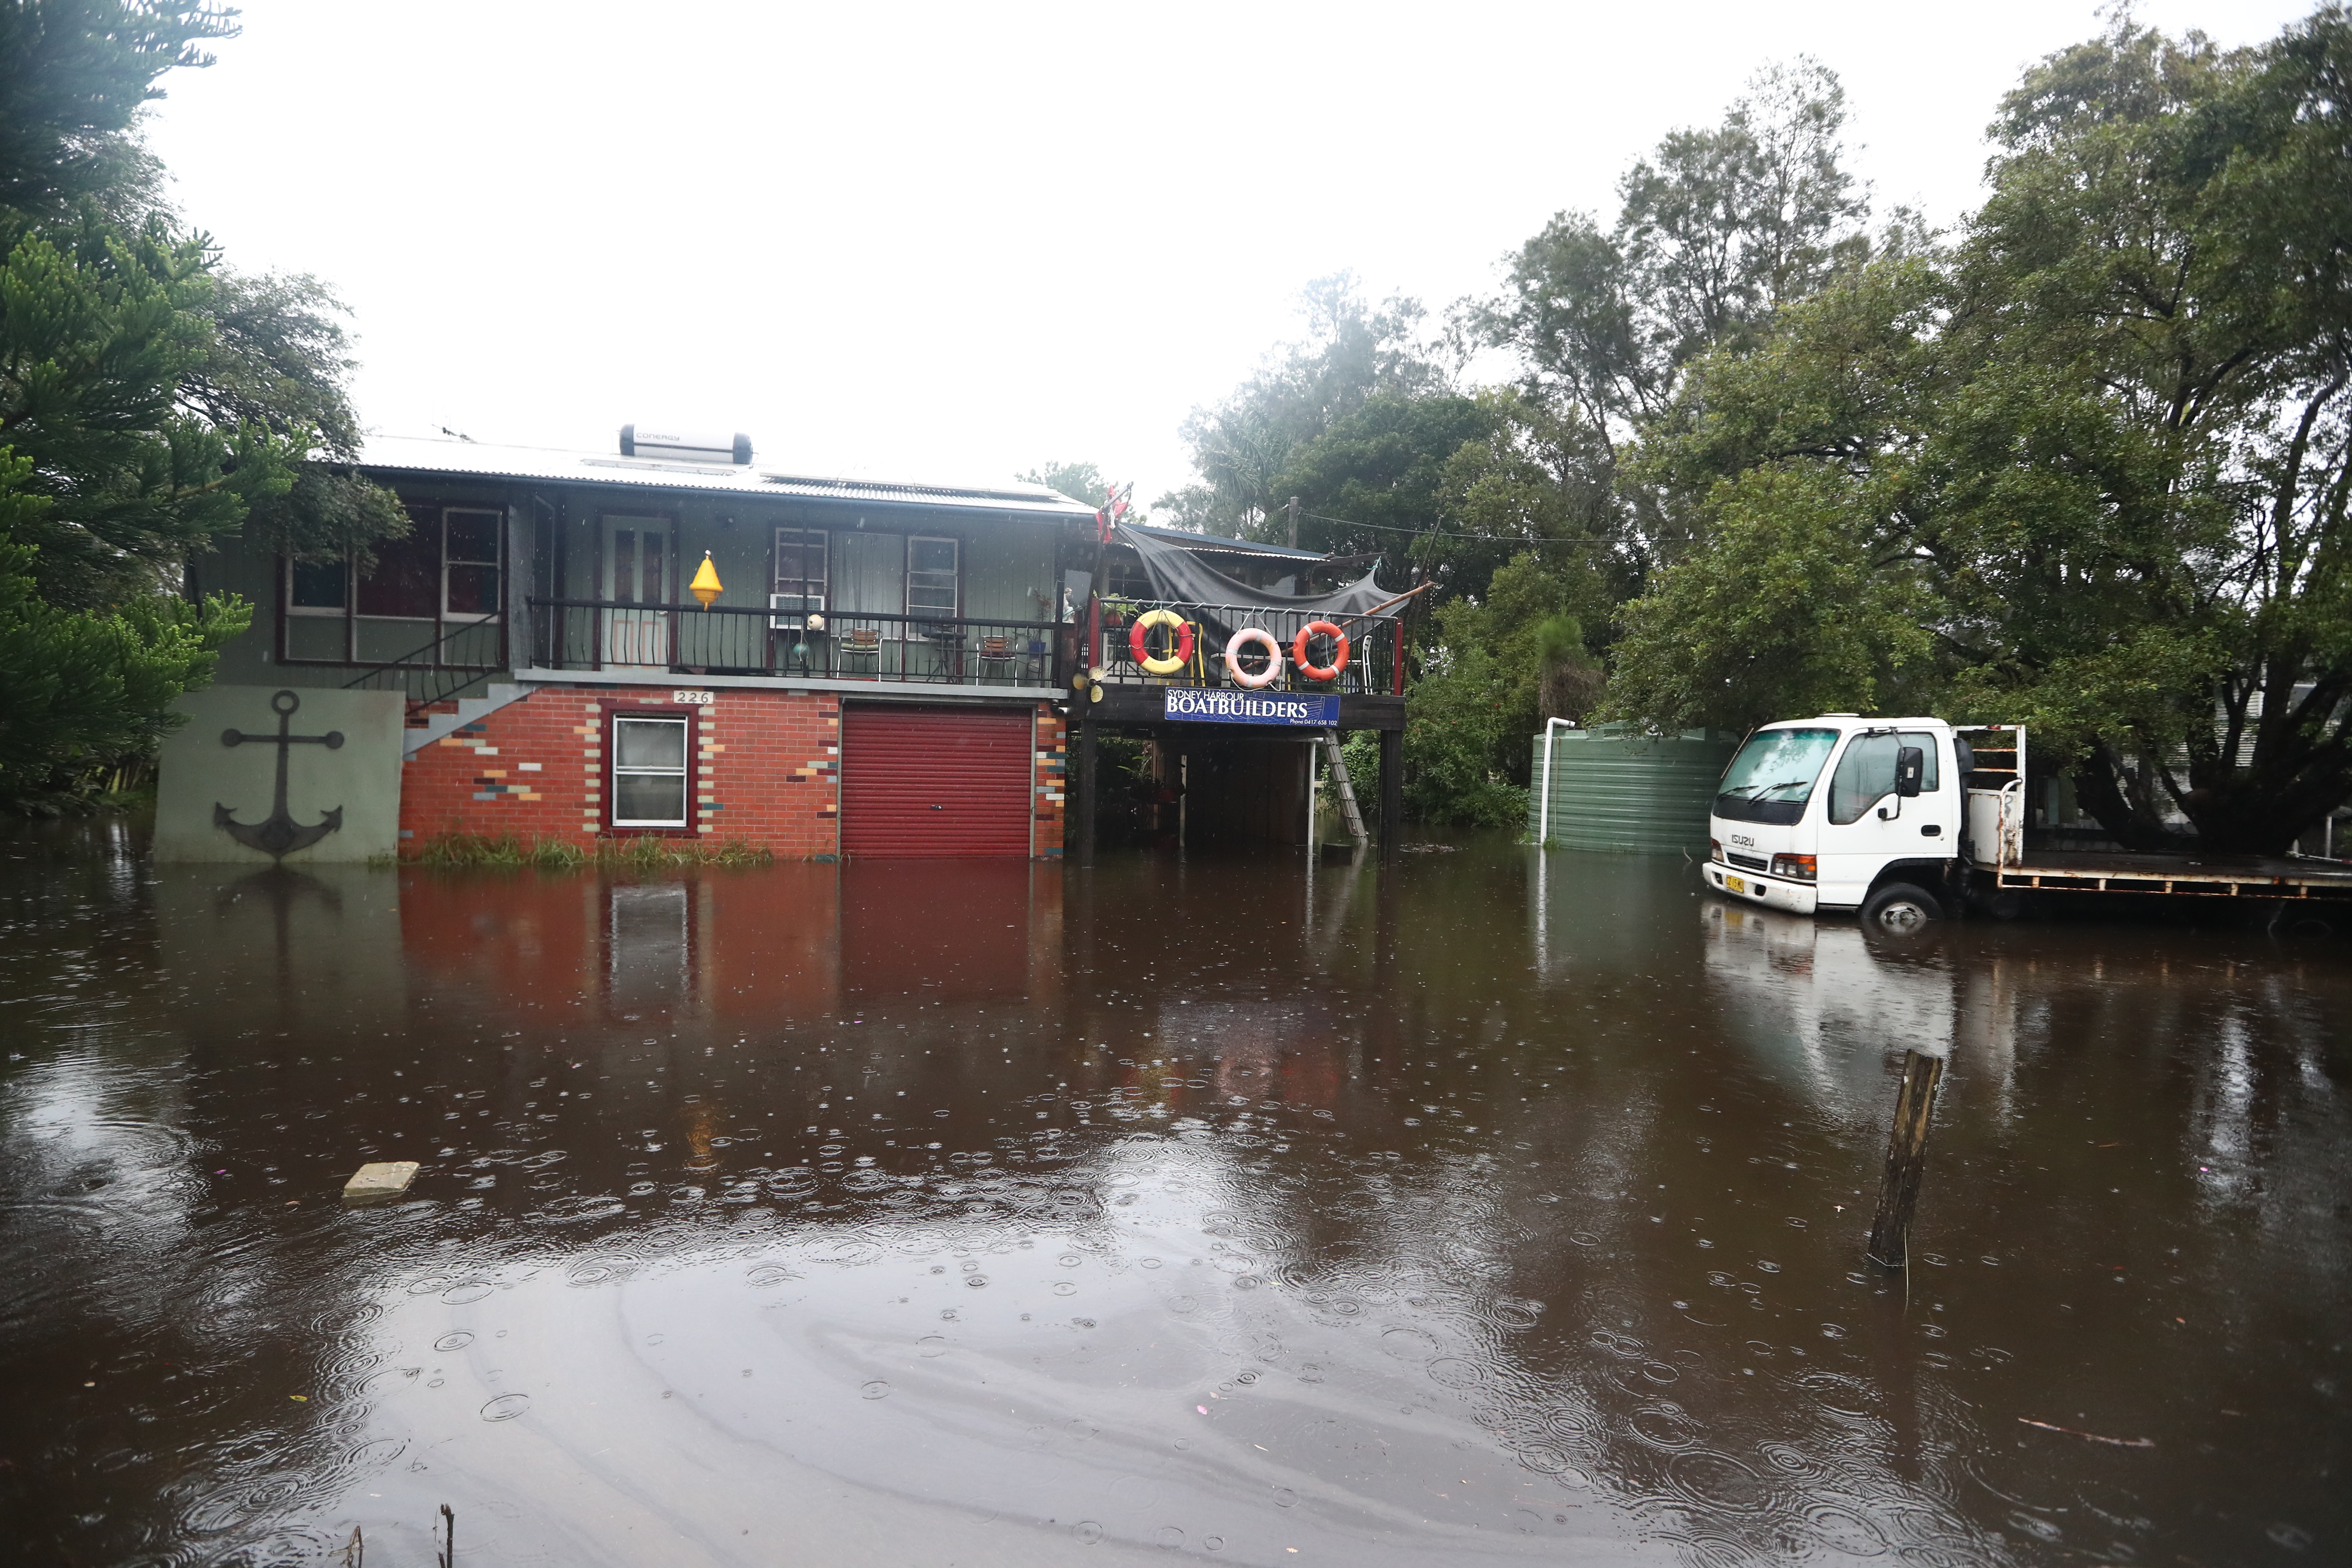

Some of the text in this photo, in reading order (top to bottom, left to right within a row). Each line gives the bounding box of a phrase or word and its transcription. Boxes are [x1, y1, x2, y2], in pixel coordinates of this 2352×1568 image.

[677, 692, 708, 703] 226
[1168, 689, 1244, 701] SYDNEY HARBOUR
[1167, 697, 1308, 718] BOATBUILDERS
[1732, 834, 1754, 846] ISUZU
